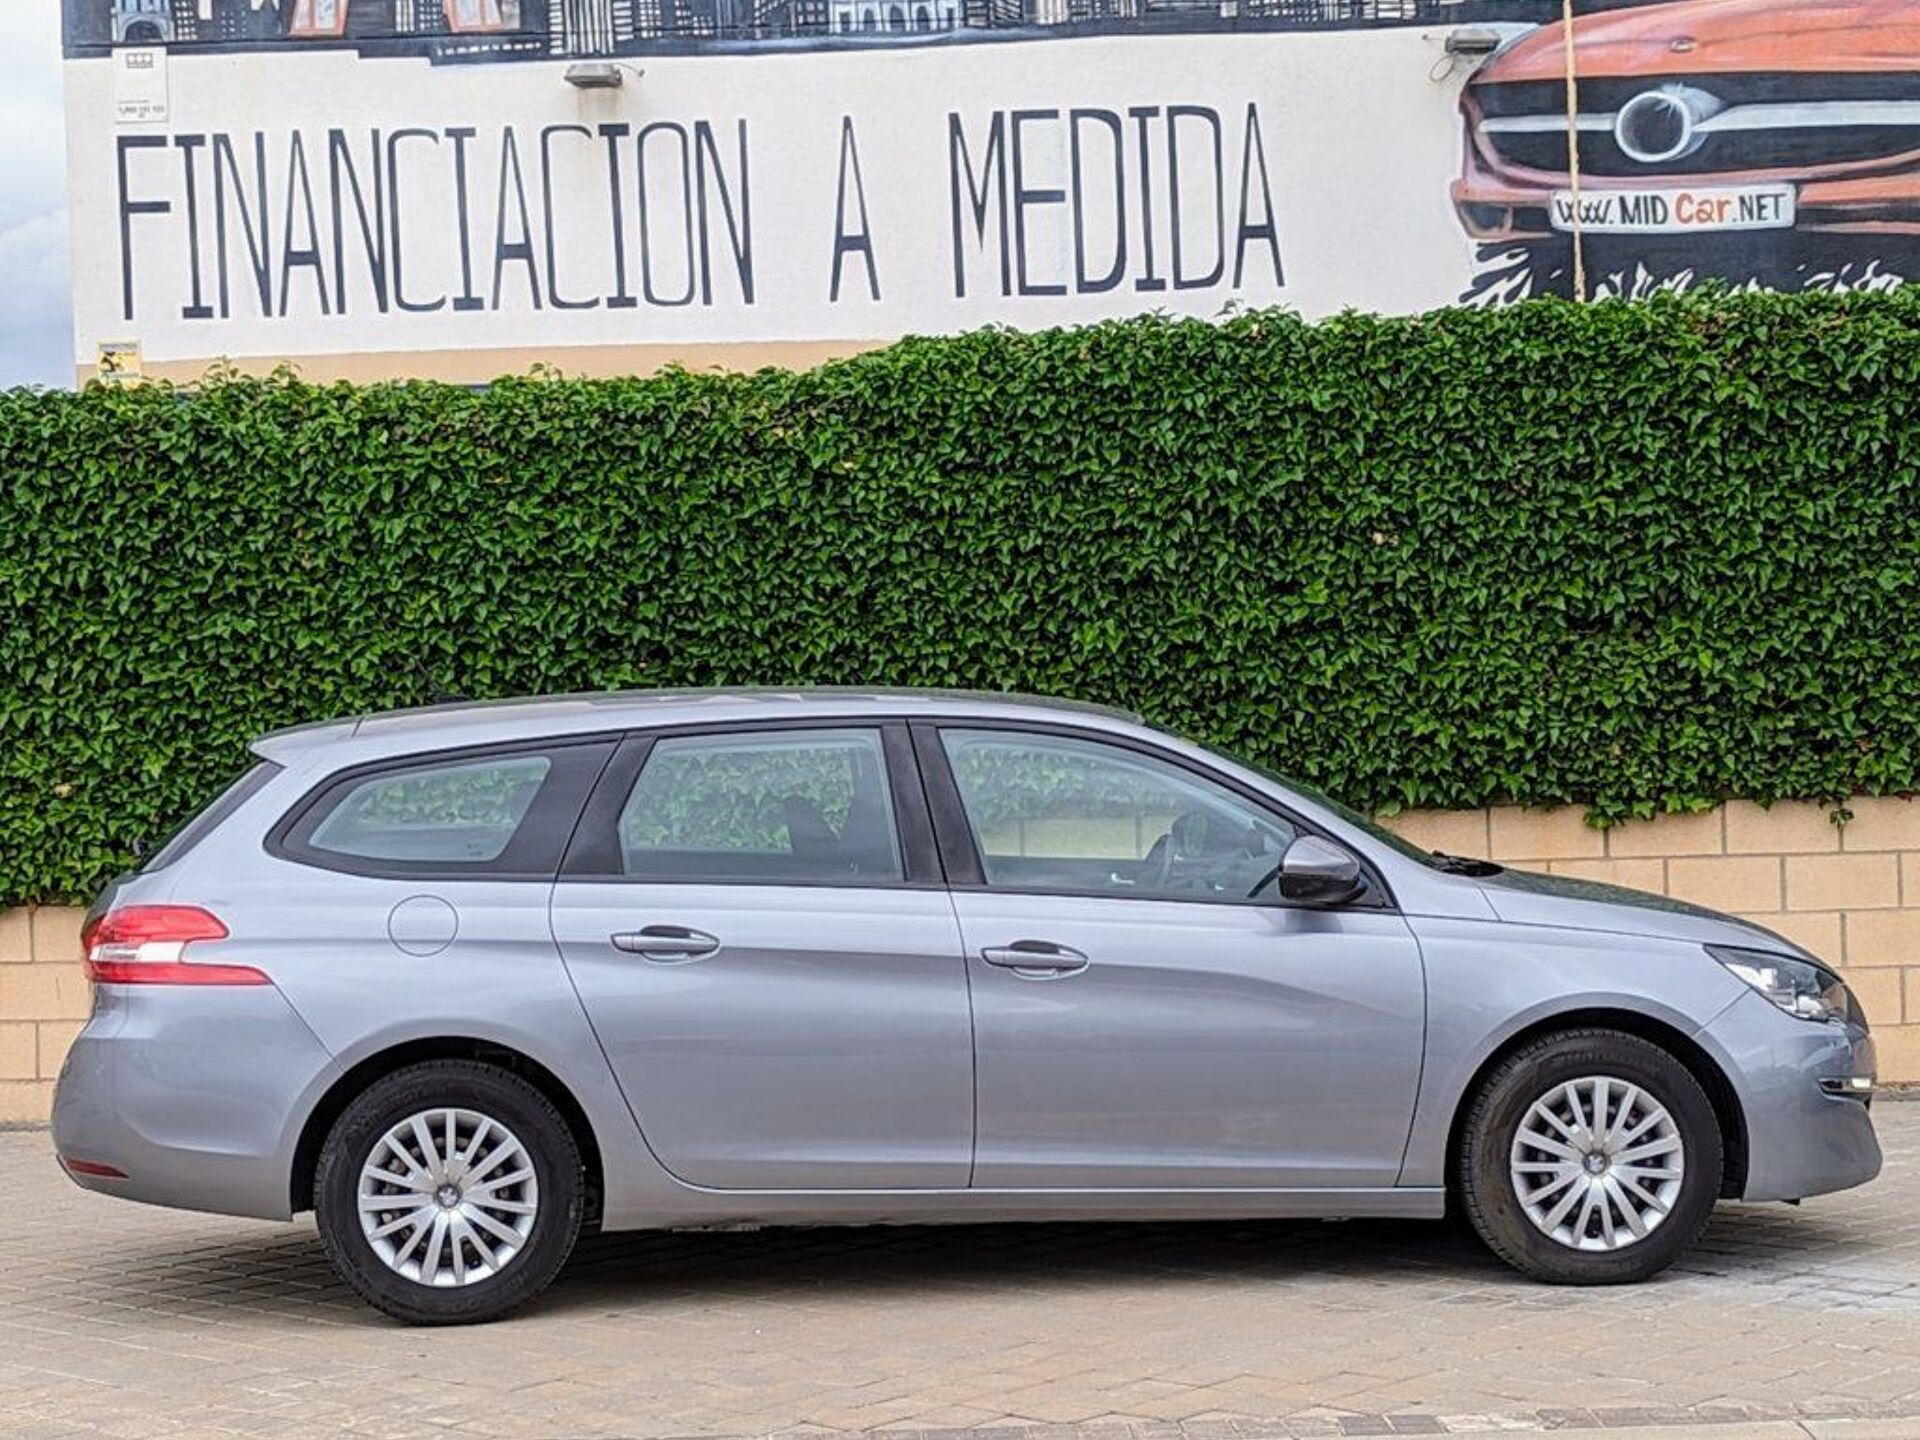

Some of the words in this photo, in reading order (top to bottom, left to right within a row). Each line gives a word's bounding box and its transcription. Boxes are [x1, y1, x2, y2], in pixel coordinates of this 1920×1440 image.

[116, 118, 754, 320] FINANCIACION
[830, 115, 881, 302] A
[948, 102, 1285, 298] MEDIDA
